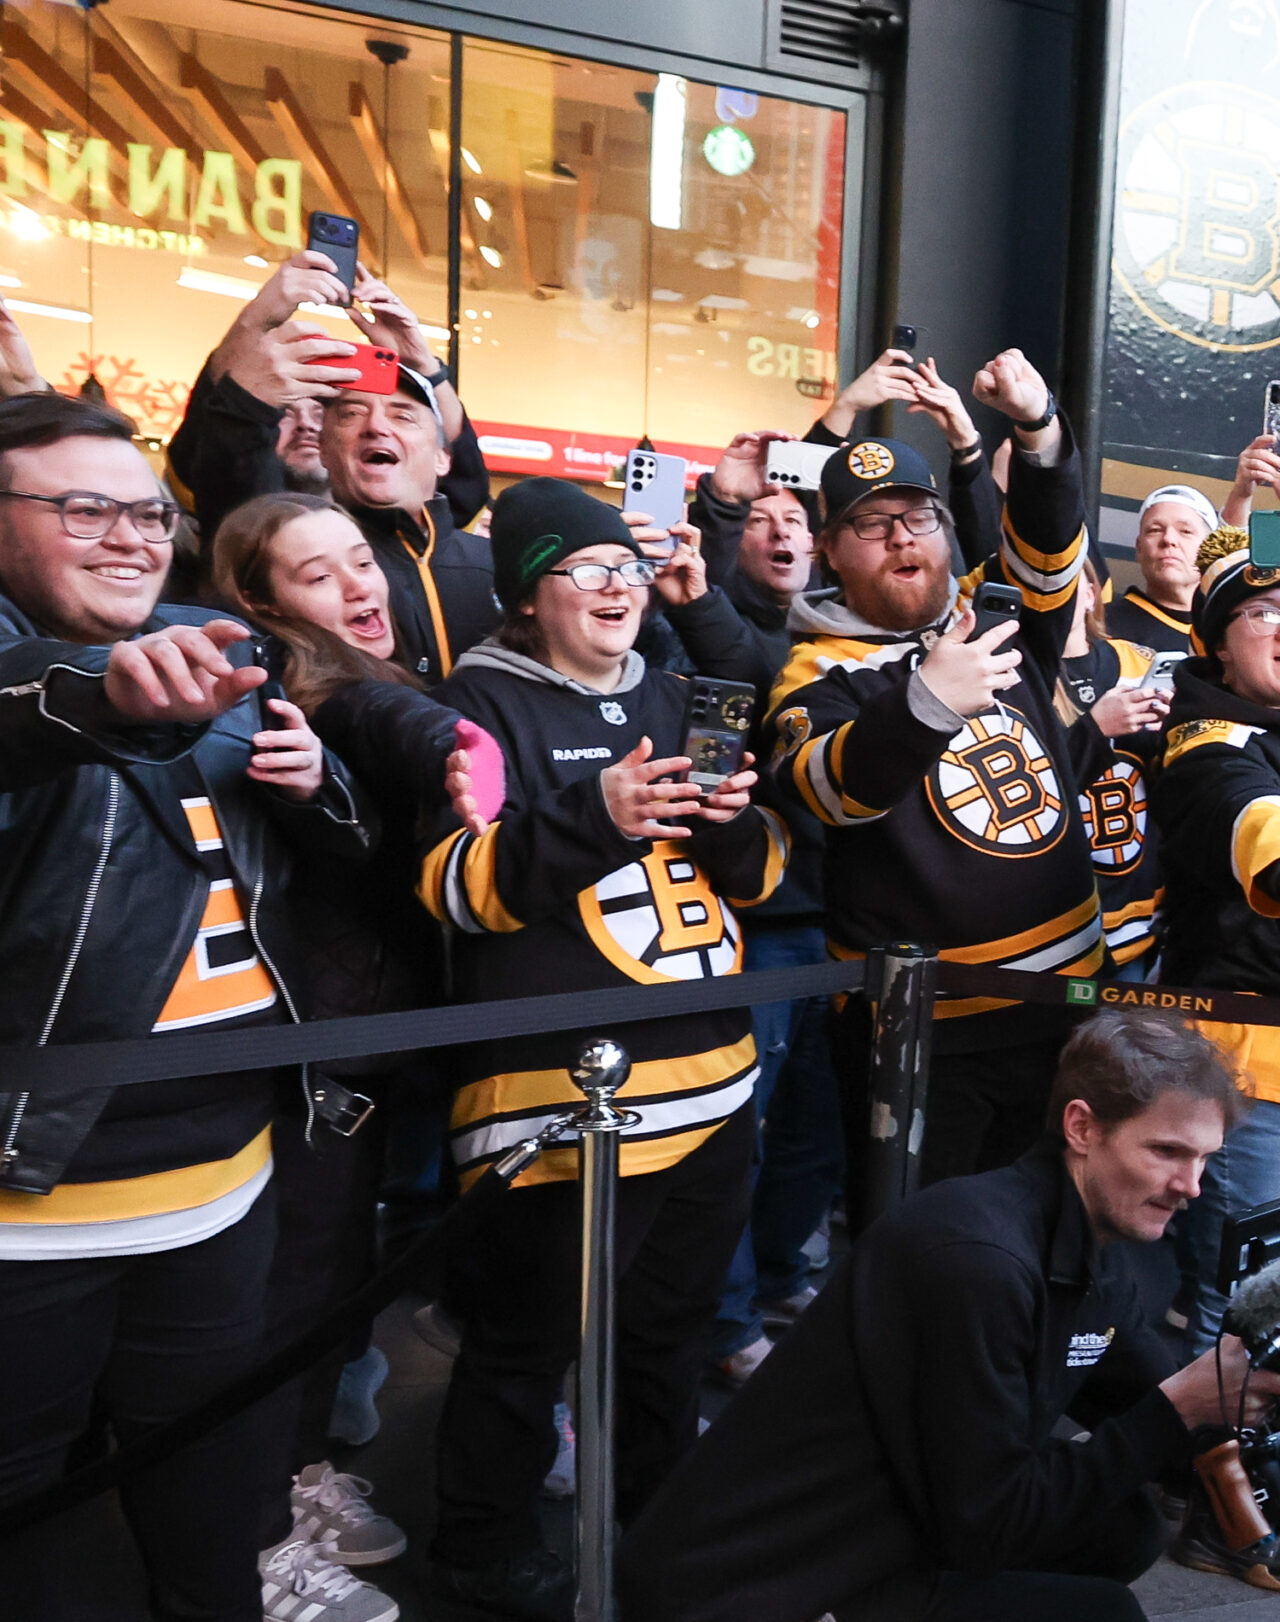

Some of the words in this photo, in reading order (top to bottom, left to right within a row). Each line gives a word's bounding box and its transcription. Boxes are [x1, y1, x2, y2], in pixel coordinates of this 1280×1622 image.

[858, 450, 883, 472] B
[956, 733, 1046, 830] B
[1085, 777, 1137, 850] B
[639, 838, 725, 953] B
[1071, 983, 1094, 1000] TD
[1101, 987, 1213, 1012] GARDEN
